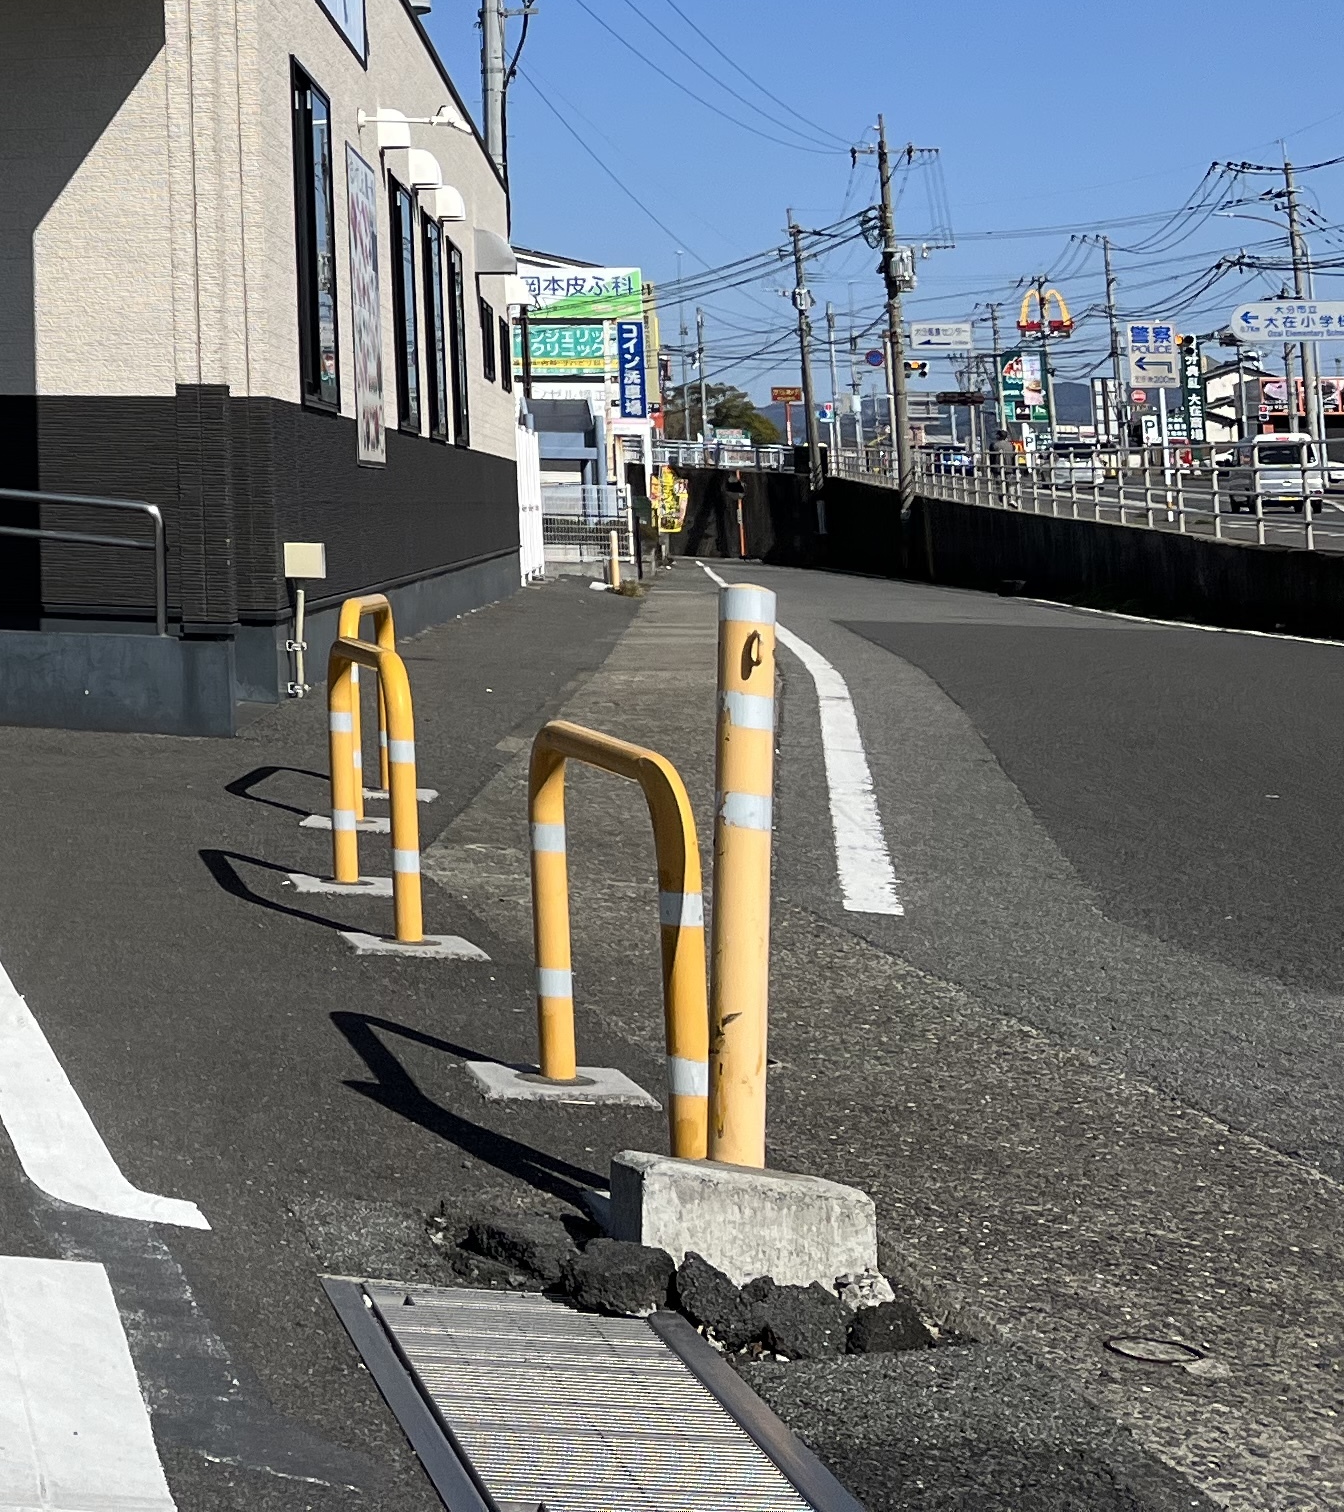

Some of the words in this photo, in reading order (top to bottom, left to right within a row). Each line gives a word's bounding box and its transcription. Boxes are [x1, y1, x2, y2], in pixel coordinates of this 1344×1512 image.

[1130, 325, 1172, 344] 警察
[1132, 345, 1172, 354] POLICE
[621, 324, 644, 417] コイン洗車場
